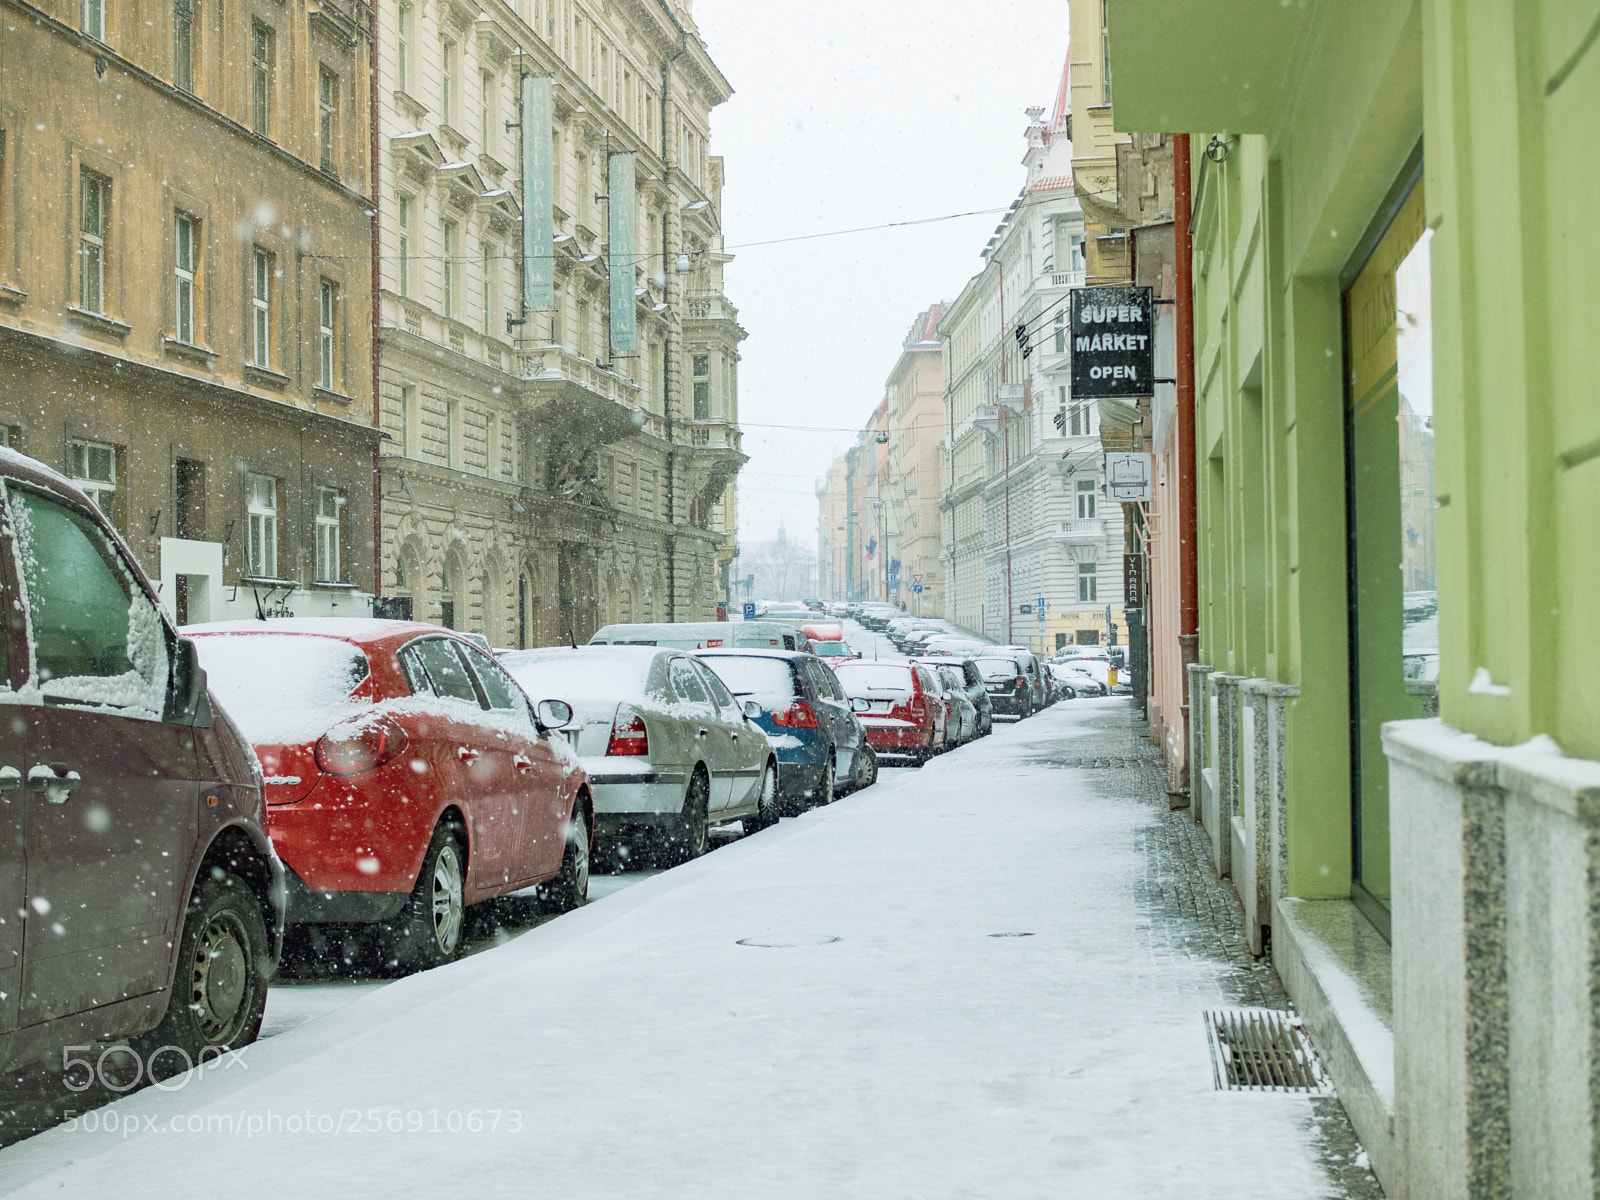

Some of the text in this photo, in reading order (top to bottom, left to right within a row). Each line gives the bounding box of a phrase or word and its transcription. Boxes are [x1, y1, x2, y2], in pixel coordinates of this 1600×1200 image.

[532, 87, 545, 257] HOTEL DAVID
[617, 163, 629, 230] HOTEL
[617, 241, 629, 309] DAVID
[1080, 305, 1143, 323] SUPER
[1076, 333, 1148, 352] MARKET
[1089, 365, 1137, 379] OPEN
